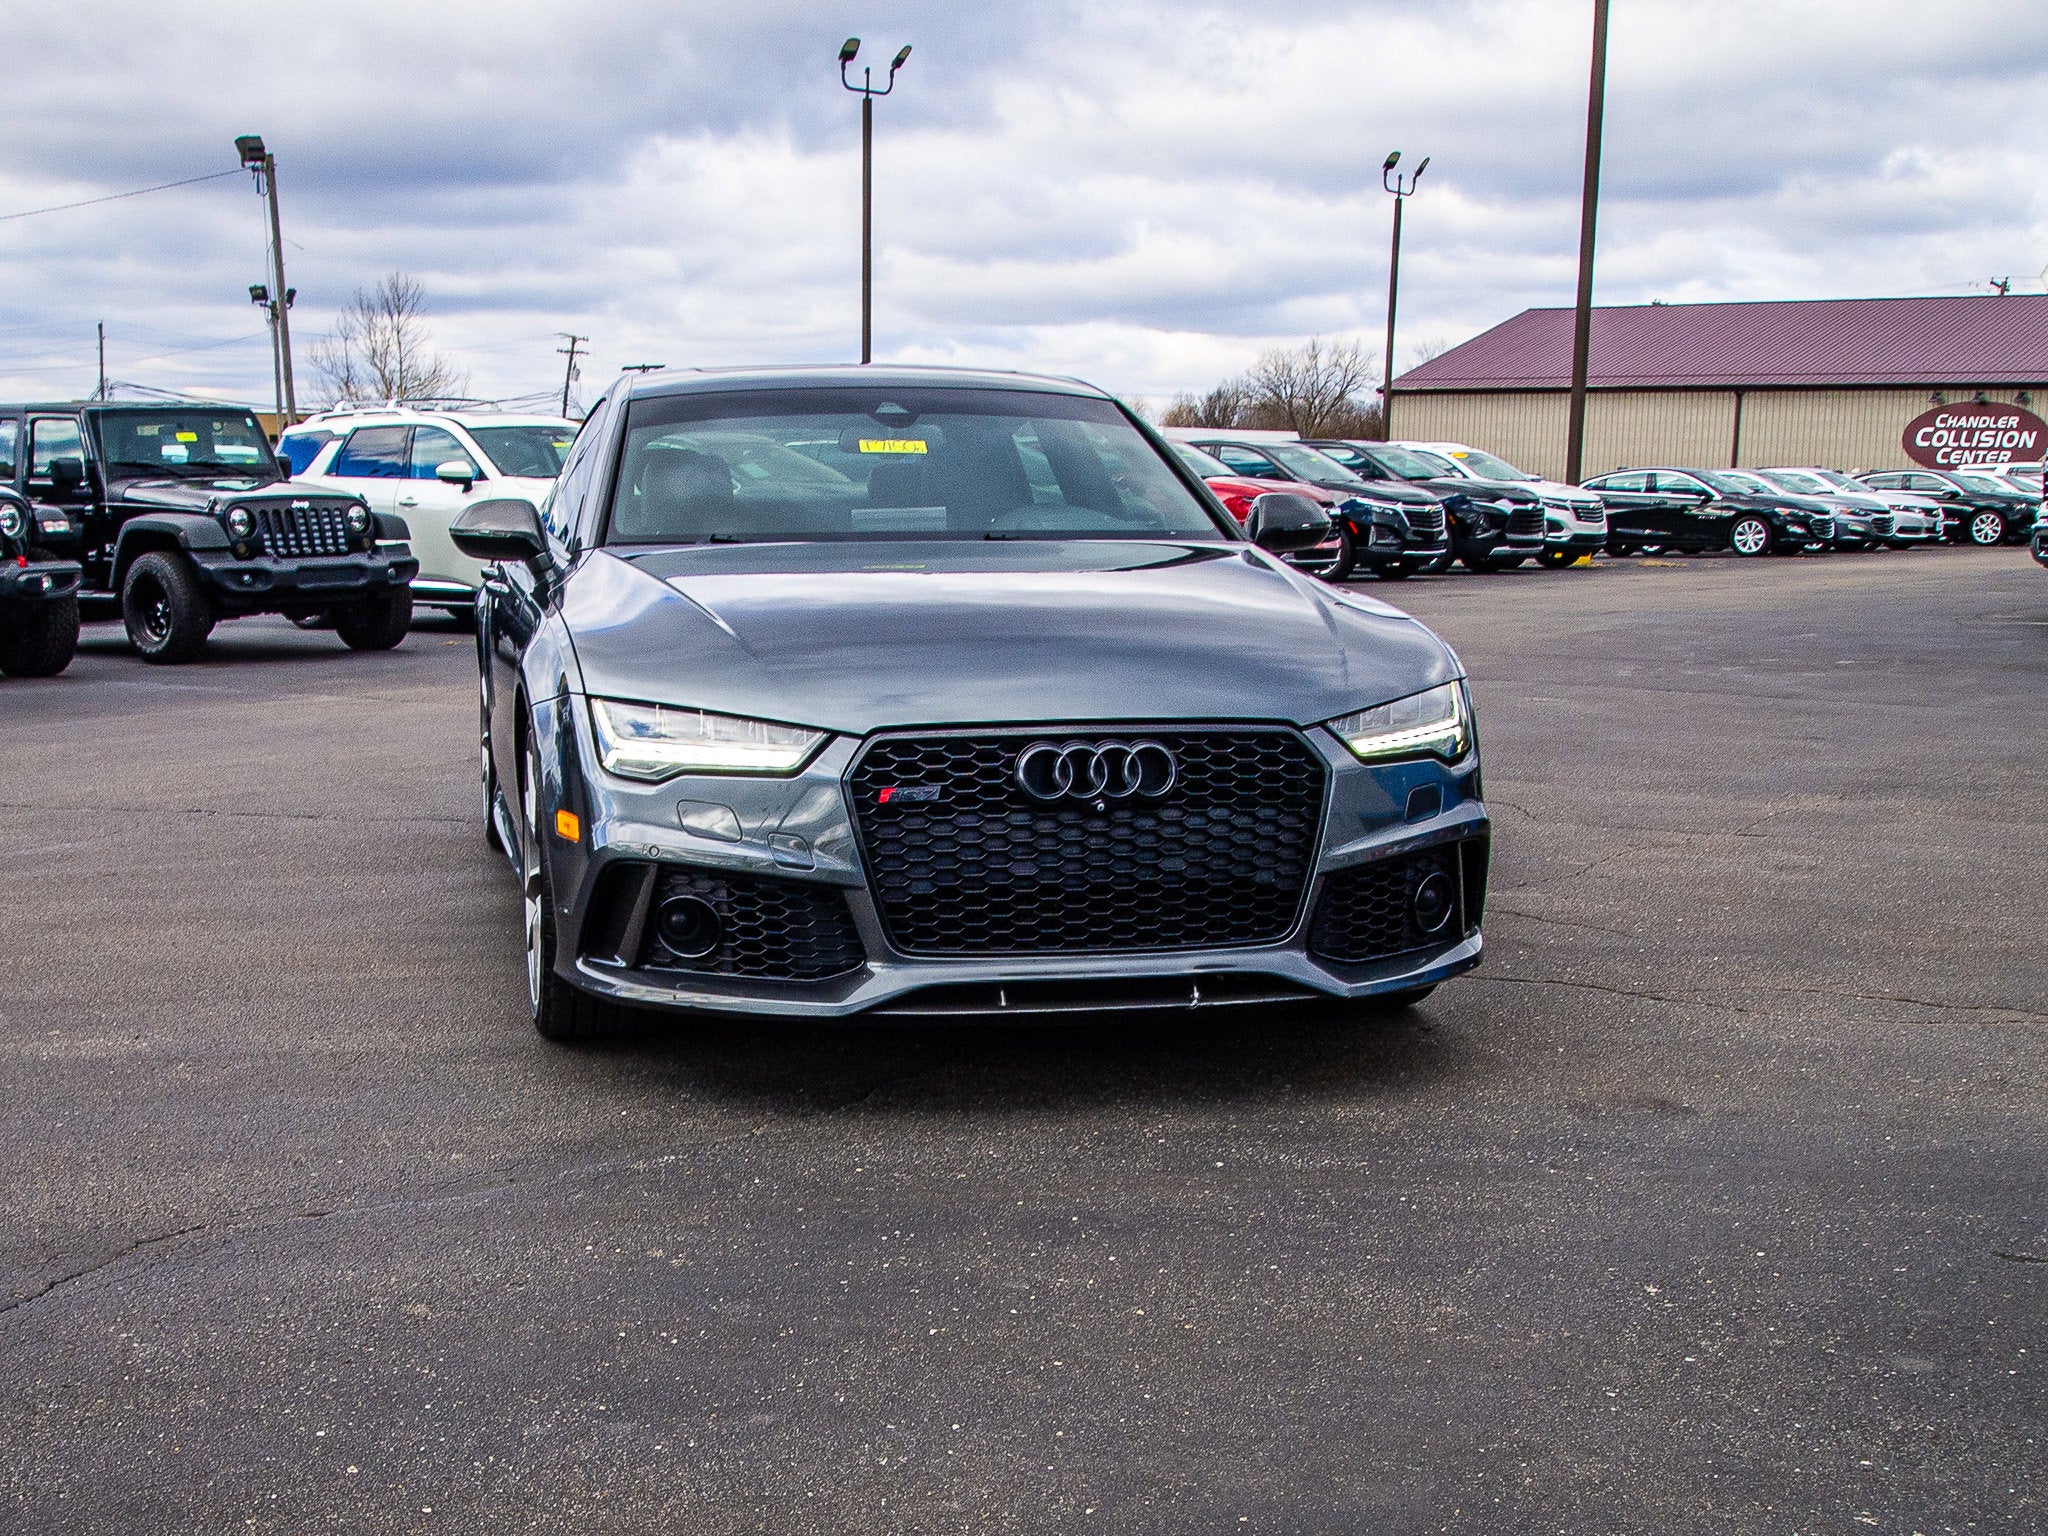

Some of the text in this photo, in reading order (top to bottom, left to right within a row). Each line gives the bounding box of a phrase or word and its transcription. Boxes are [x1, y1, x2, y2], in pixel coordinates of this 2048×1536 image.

[1935, 413, 2020, 429] CHANDLER
[1915, 426, 2038, 449] COLLISION
[1935, 447, 2012, 464] CENTER
